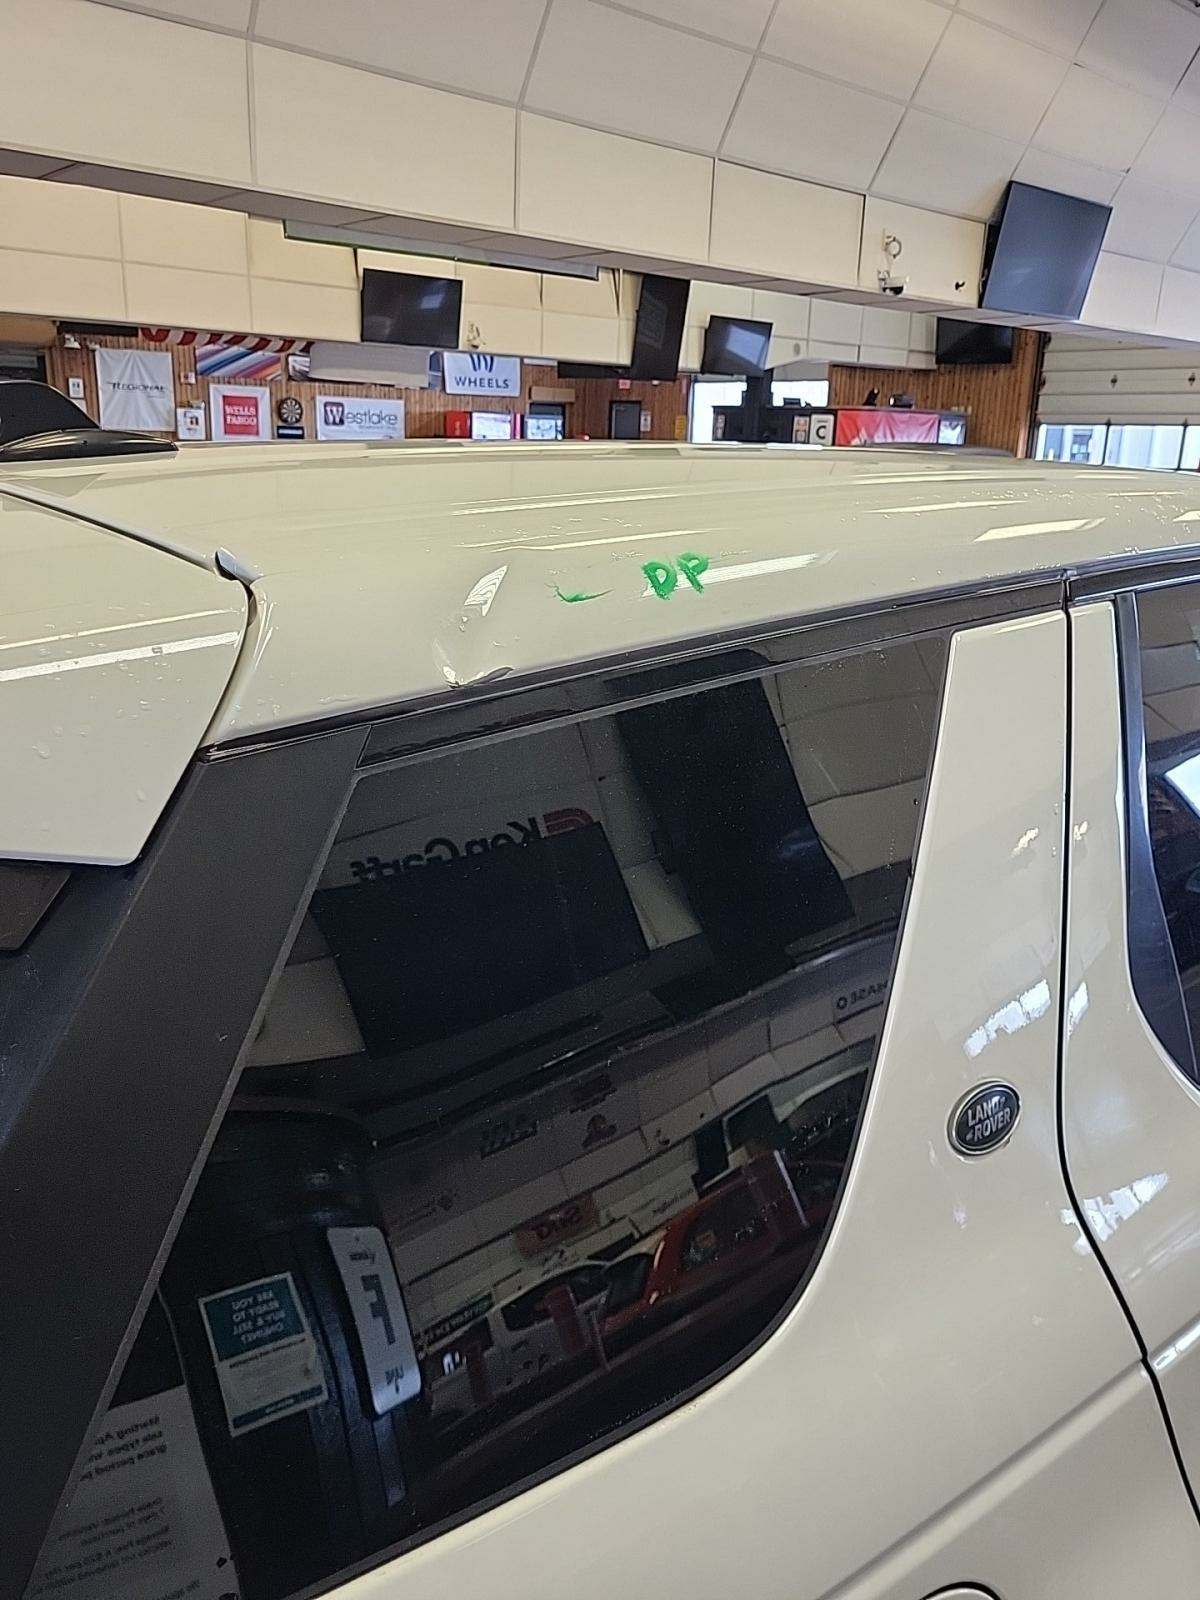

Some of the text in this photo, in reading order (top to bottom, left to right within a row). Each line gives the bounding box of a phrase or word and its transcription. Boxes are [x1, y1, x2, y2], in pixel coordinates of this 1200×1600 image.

[454, 376, 509, 389] WHEELS
[225, 405, 256, 415] WELLS
[324, 402, 398, 426] Westlake
[226, 415, 257, 425] FARGO
[816, 425, 828, 439] C
[967, 1096, 1001, 1127] LAND
[974, 1107, 1011, 1142] ROVER
